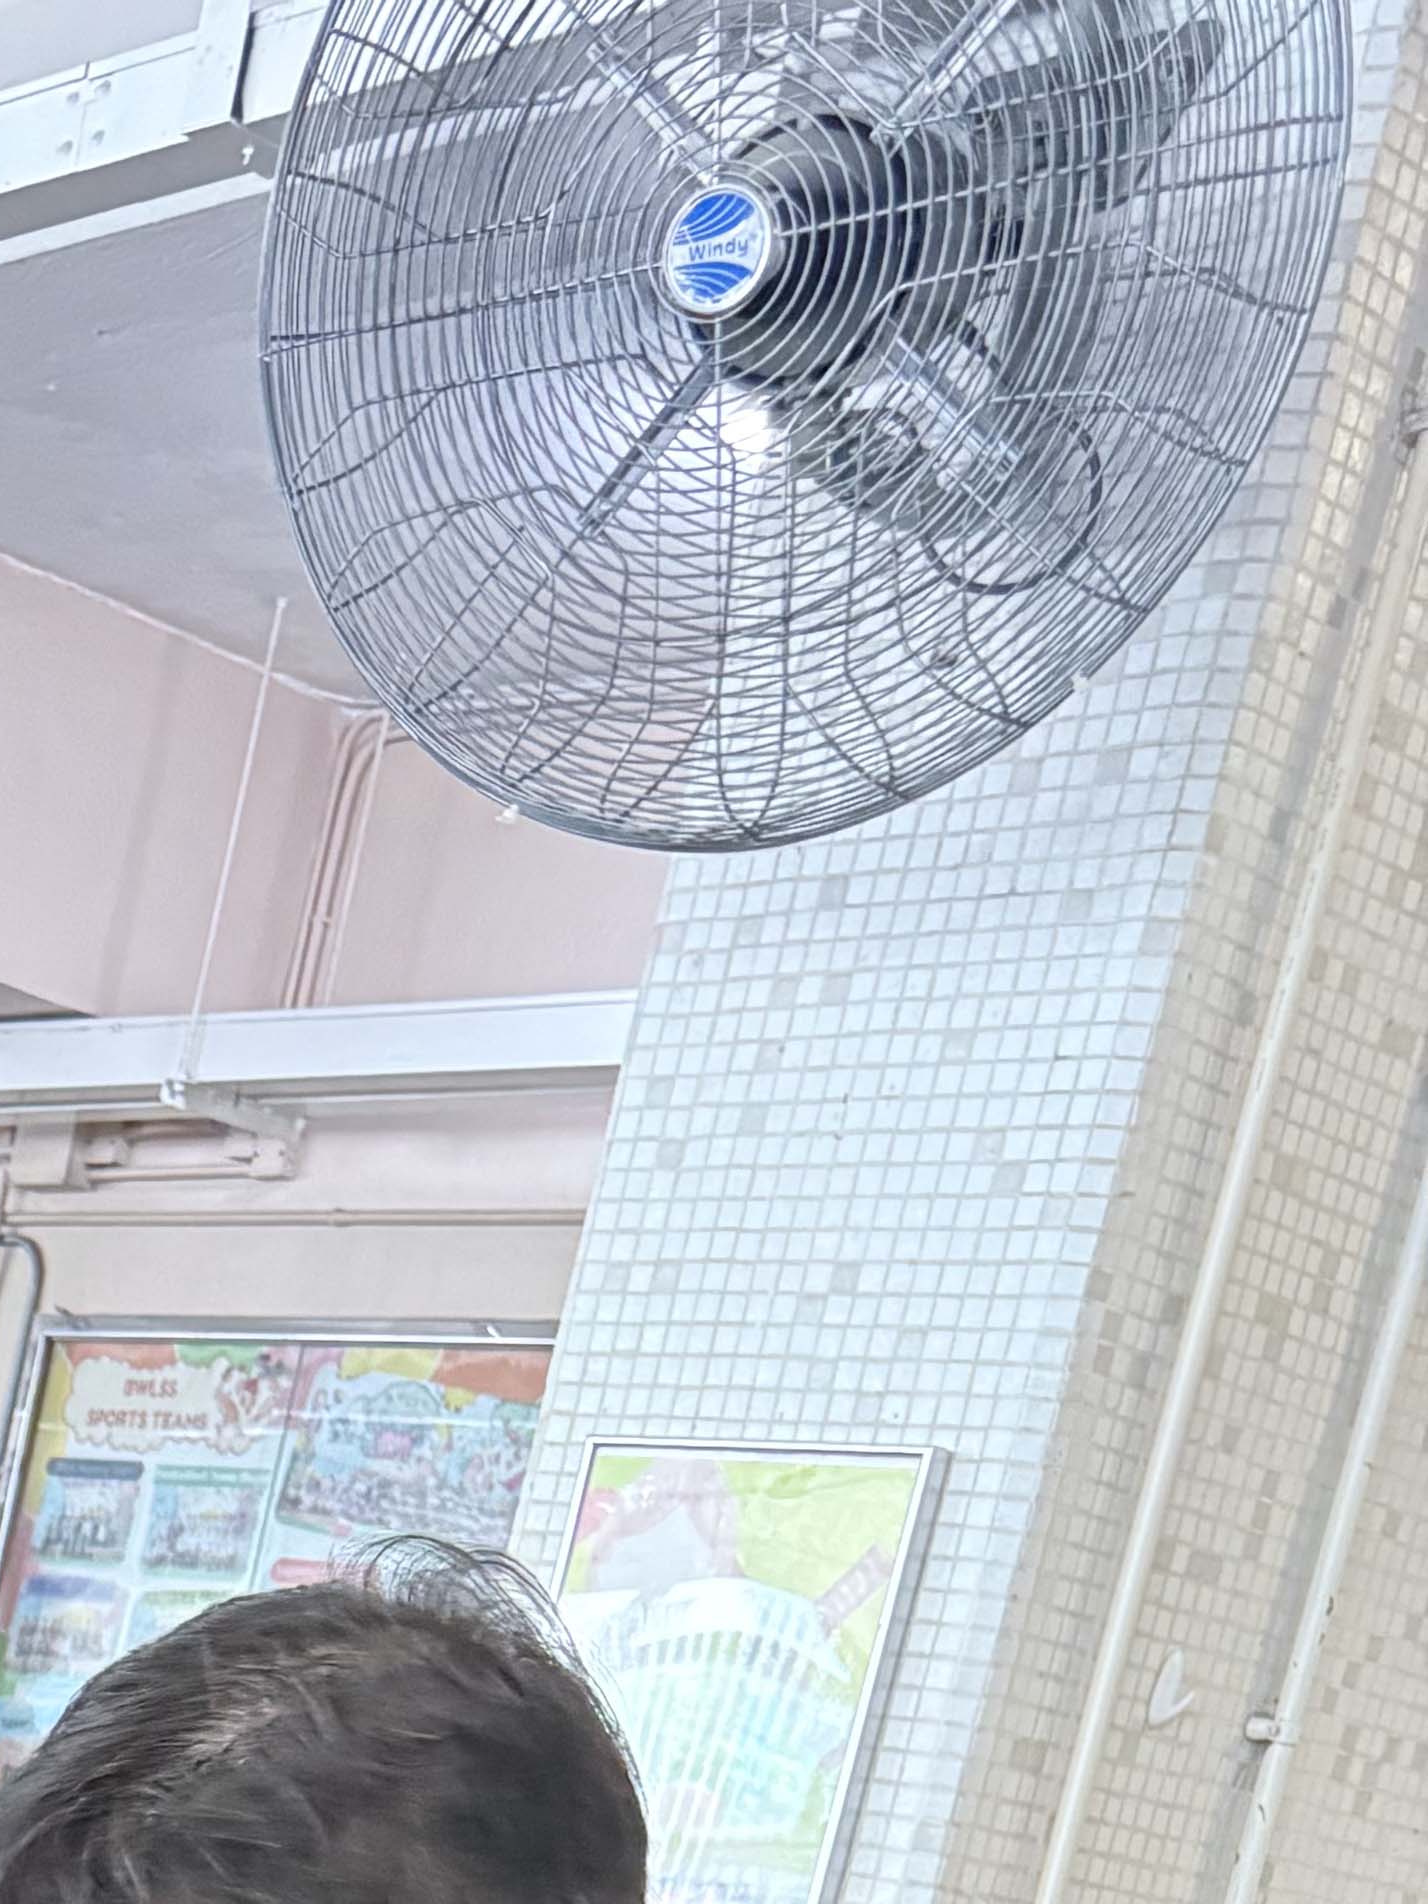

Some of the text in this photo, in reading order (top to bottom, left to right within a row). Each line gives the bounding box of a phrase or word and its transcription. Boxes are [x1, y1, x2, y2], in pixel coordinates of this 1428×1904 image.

[688, 236, 749, 262] Windy
[86, 1407, 208, 1430] SPORTS TEAMS
